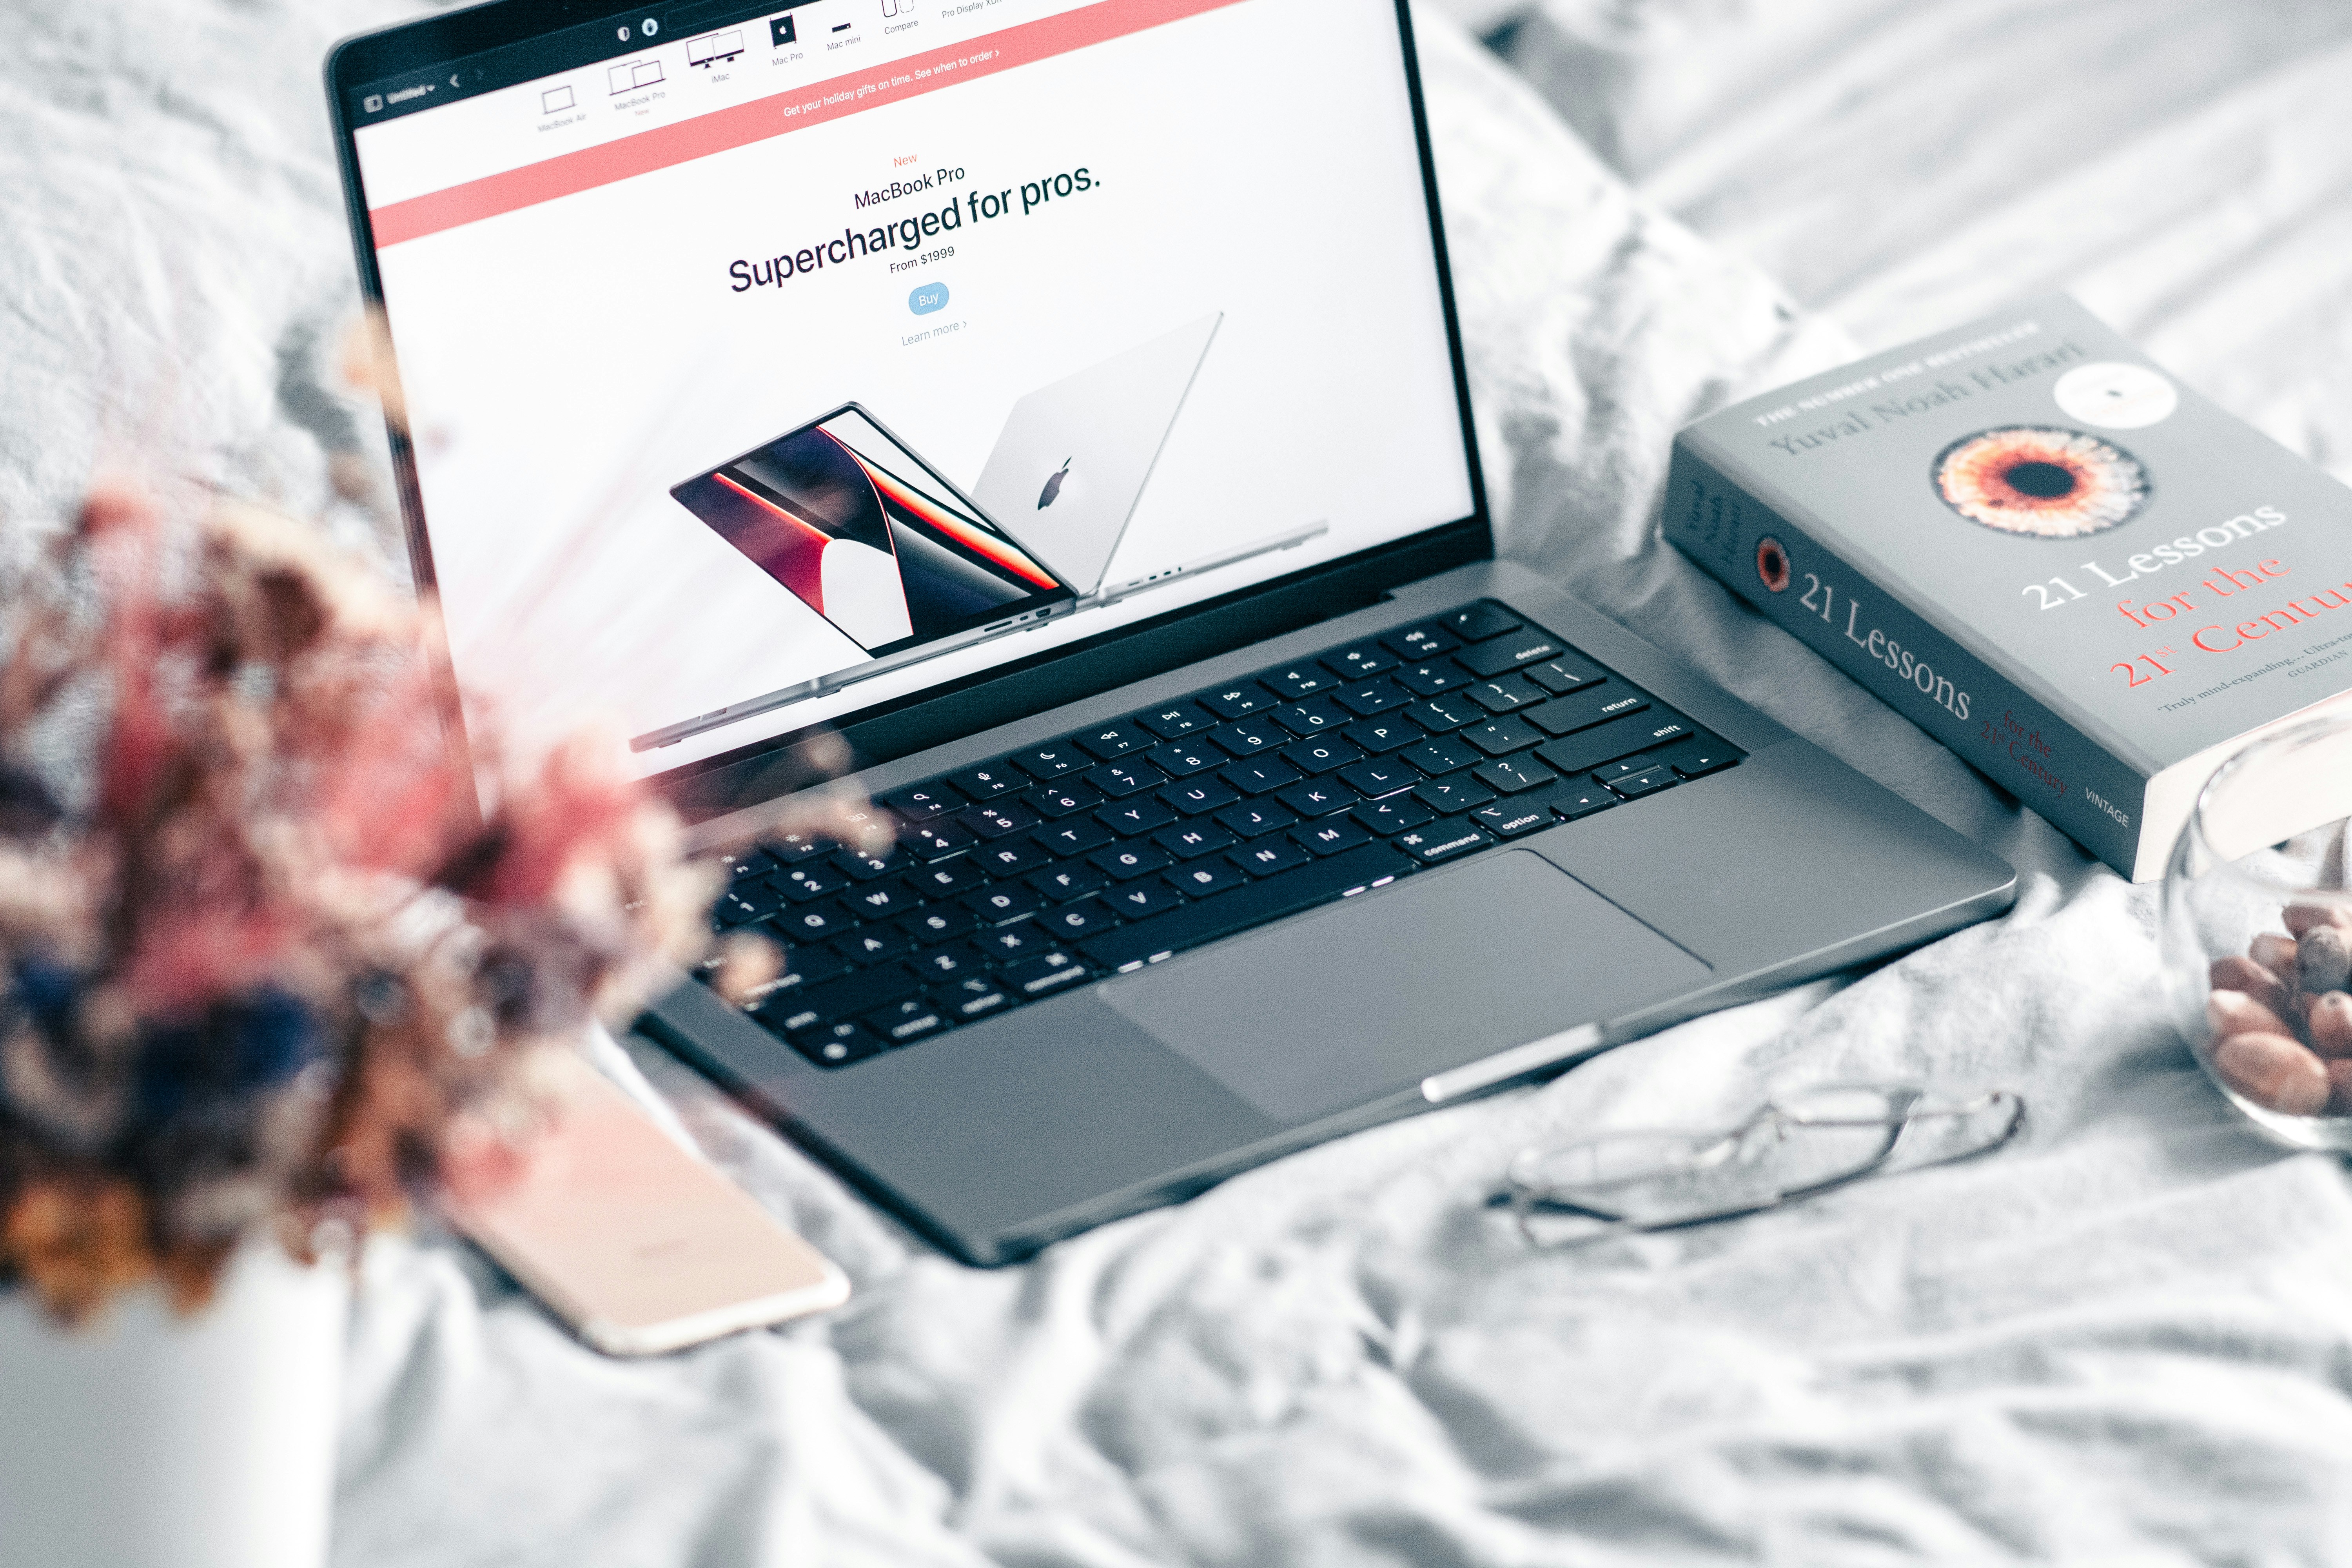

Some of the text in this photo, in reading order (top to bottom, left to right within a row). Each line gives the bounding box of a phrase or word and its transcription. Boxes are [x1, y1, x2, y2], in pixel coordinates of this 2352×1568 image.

[942, 10, 955, 18] Pro
[956, 2, 984, 15] Display
[884, 19, 918, 34] Compare
[827, 35, 861, 51] Mac mini
[771, 52, 803, 66] Mac Pro
[711, 73, 730, 83] iMac
[784, 50, 993, 117] Get your holiday gifts on time. See when to order
[614, 91, 666, 111] MacBook Pro
[537, 113, 587, 132] MacBook Air
[893, 154, 917, 168] New
[854, 167, 965, 210] MacBook Pro
[728, 167, 1100, 293] Supercharged for pros.
[889, 246, 955, 274] From $1999
[918, 292, 939, 307] Buy
[901, 322, 960, 347] Learn more
[1752, 406, 1797, 426] THE
[1797, 376, 1880, 410] NUMBER
[1769, 341, 2086, 456] Yuval Noah Harari
[2022, 504, 2287, 611] 21 Lessons
[2116, 559, 2292, 630] for the
[1515, 645, 1550, 660] delete
[1800, 573, 1971, 720] 21 Lessons
[2110, 644, 2178, 688] 21st
[2288, 649, 2348, 678] GUARDIAN
[1601, 698, 1637, 712] return
[1309, 716, 1323, 724] 0
[1374, 728, 1387, 738] P
[1653, 725, 1681, 737] shift
[2004, 710, 2051, 758] for the
[1247, 737, 1262, 745] 9
[1313, 749, 1329, 758] O
[1186, 757, 1201, 765] 8
[1498, 763, 1512, 772] ?
[2009, 741, 2068, 799] Century
[1122, 777, 1134, 786] 7
[1187, 789, 1205, 799] U
[1308, 791, 1327, 802] K
[1060, 798, 1075, 806] 6
[2085, 787, 2129, 828] VINTAGE
[1125, 810, 1140, 819] Y
[1251, 813, 1261, 822] J
[996, 818, 1012, 828] 5
[1502, 815, 1539, 829] option
[1061, 830, 1076, 840] T
[1183, 832, 1202, 844] H
[1318, 829, 1339, 841] M
[936, 838, 949, 848] 4
[1424, 833, 1481, 857] command
[998, 852, 1017, 862] R
[1120, 854, 1137, 864] G
[1256, 850, 1276, 862] N
[868, 859, 885, 869] 3
[935, 872, 953, 884] E
[1193, 871, 1212, 883] B
[804, 880, 821, 891] 2
[866, 892, 889, 905] W
[1129, 892, 1146, 904] V
[804, 915, 825, 927] Q
[1066, 913, 1085, 926] C
